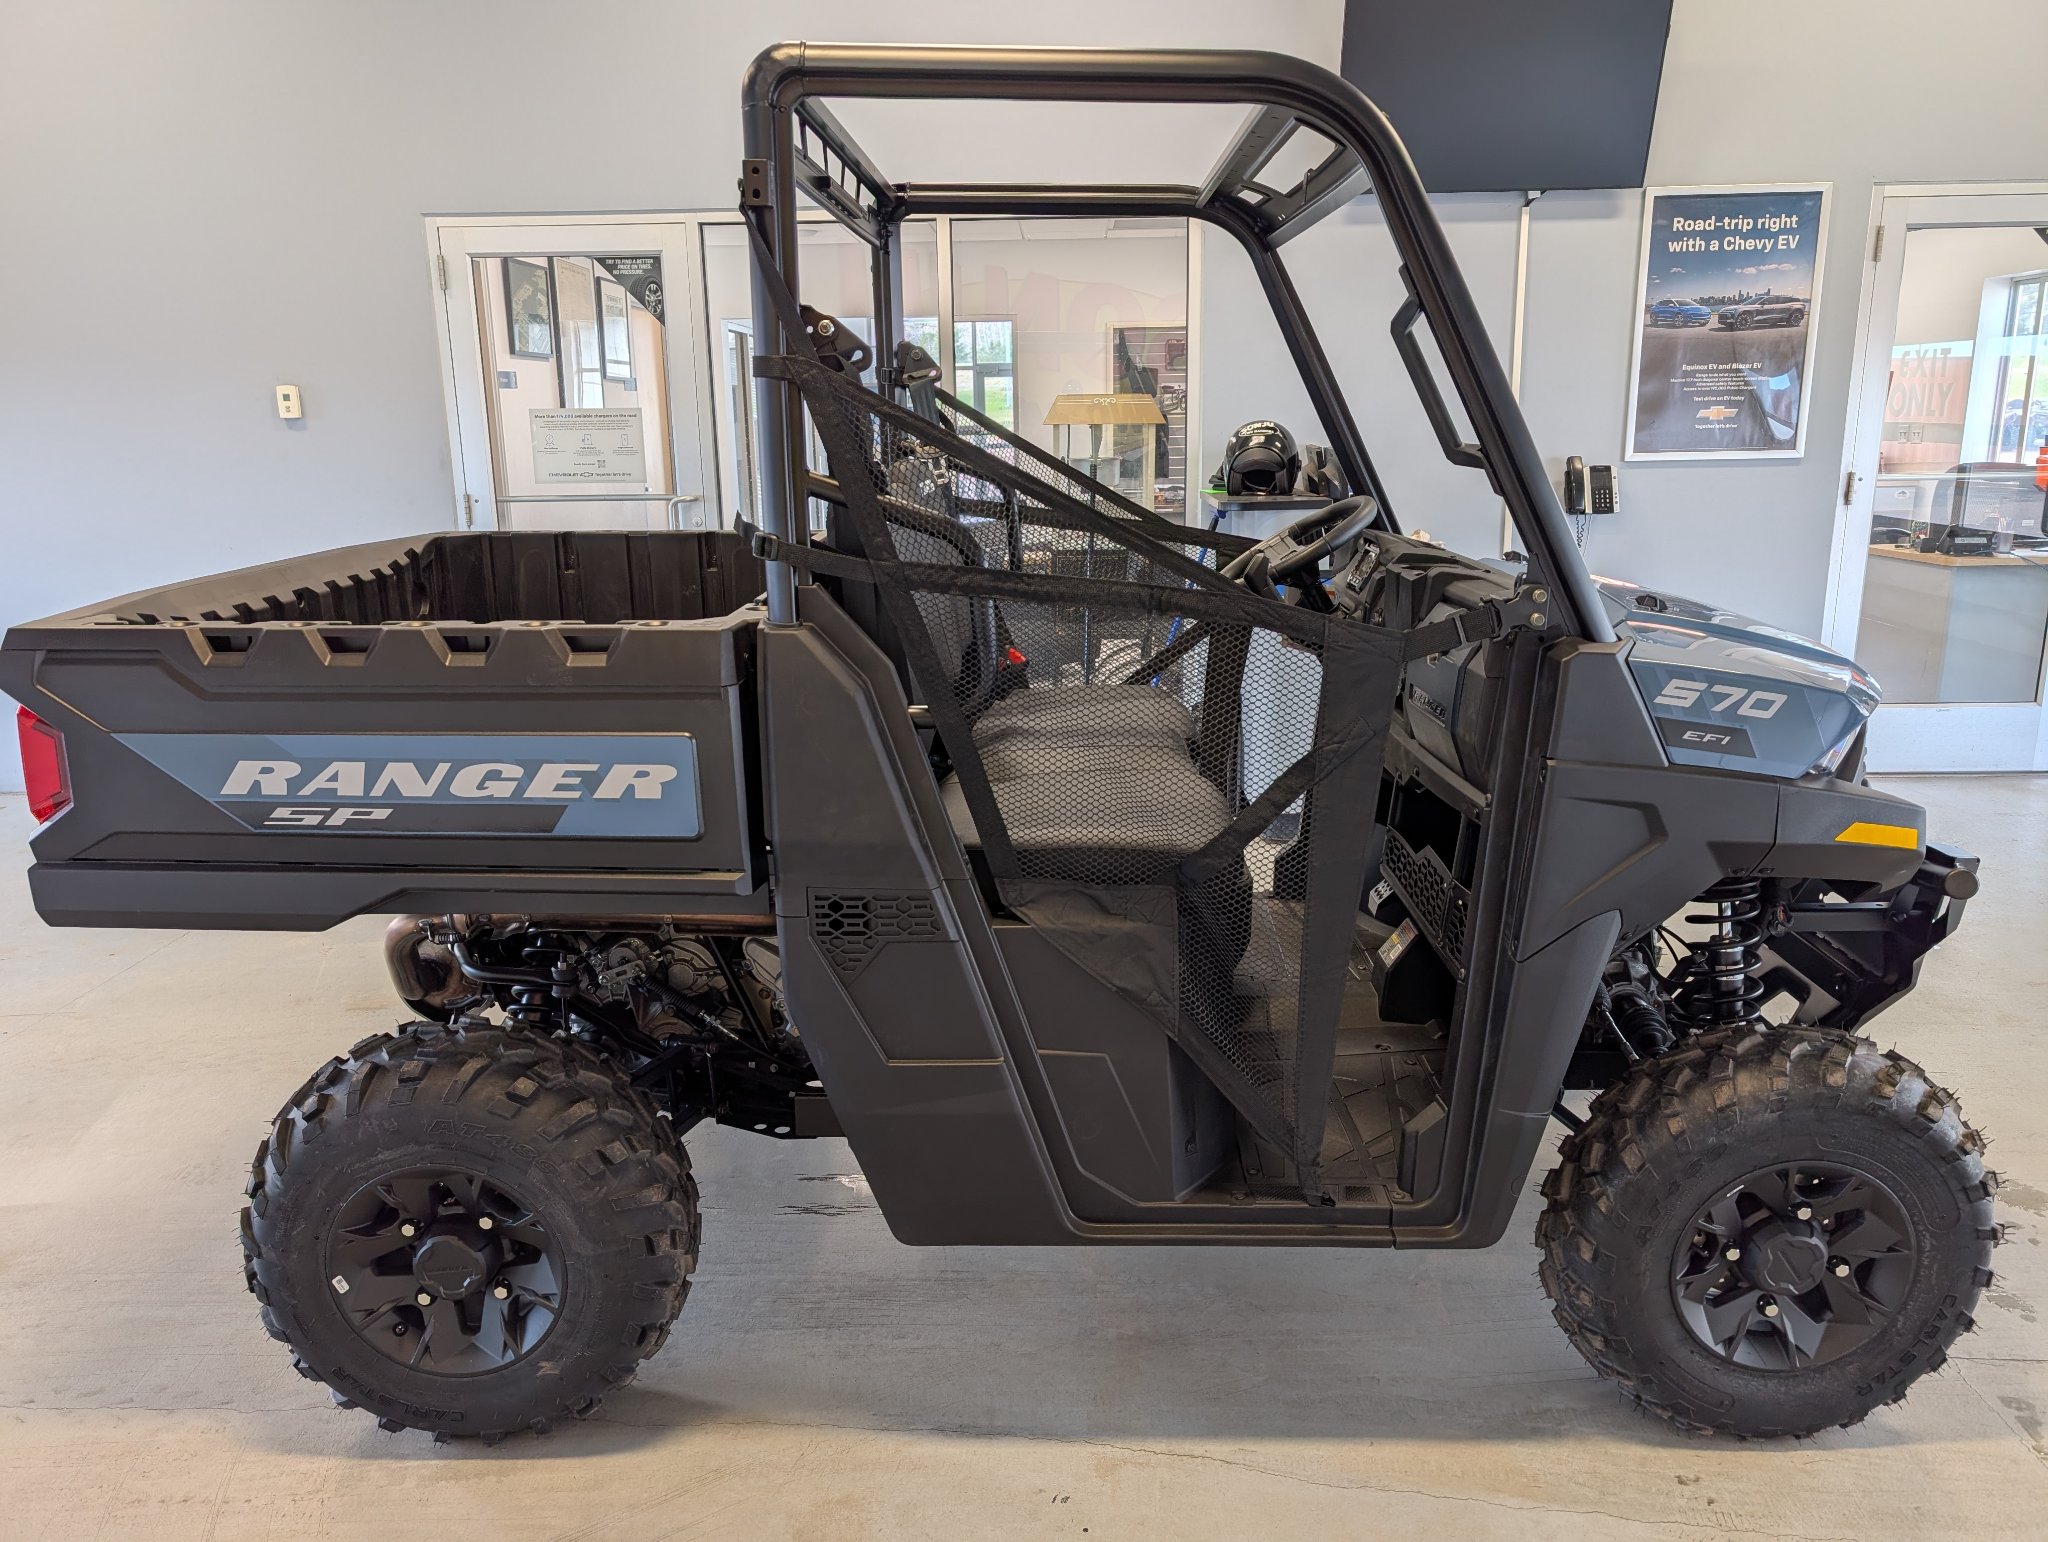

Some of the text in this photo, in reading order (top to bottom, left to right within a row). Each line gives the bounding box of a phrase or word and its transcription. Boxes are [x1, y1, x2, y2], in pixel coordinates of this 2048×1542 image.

[1672, 213, 1798, 232] Road-trip right
[1668, 235, 1800, 252] with a Chevy EV
[1900, 348, 1952, 377] EXIT
[1888, 382, 1956, 417] ONLY
[1653, 678, 1788, 718] 570
[1682, 730, 1731, 746] EFI
[220, 760, 678, 799] RANGER
[264, 807, 394, 826] SP
